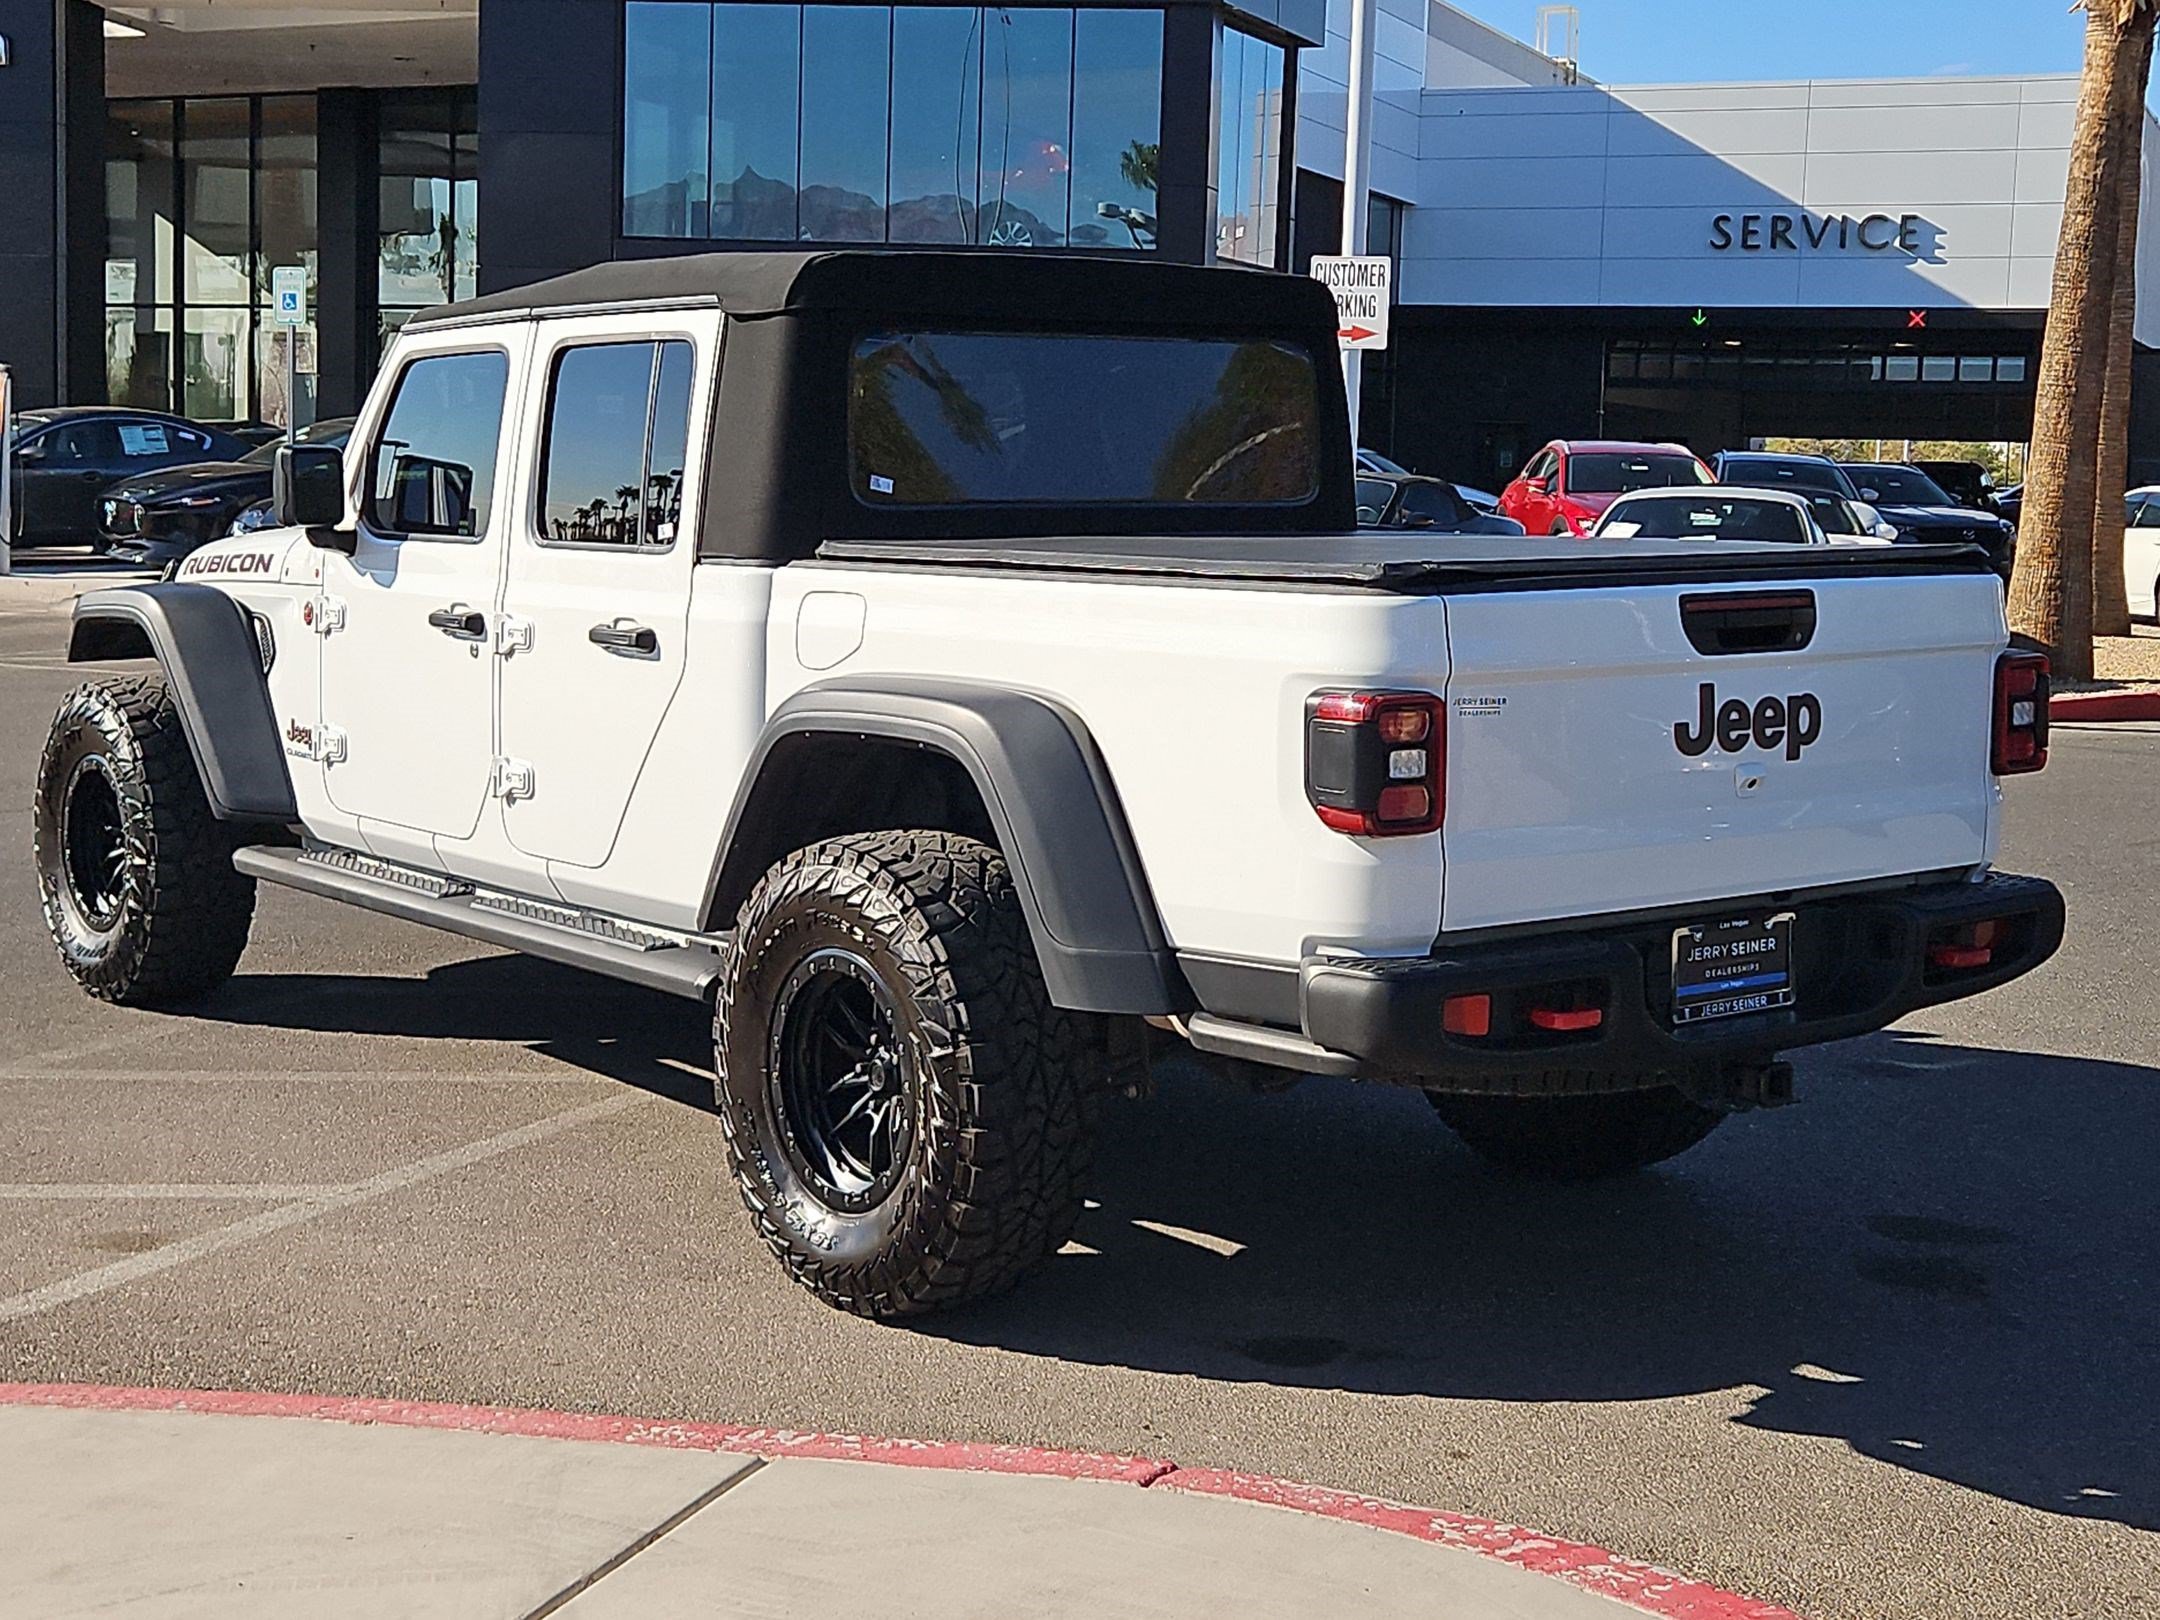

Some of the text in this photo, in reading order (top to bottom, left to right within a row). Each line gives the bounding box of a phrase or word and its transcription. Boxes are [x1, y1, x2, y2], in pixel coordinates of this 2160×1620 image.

[1709, 214, 1920, 250] SERVICE
[1315, 262, 1386, 287] CUSTOMER
[1337, 293, 1377, 318] RKING
[183, 553, 275, 576] RUBICON
[1673, 682, 1822, 762] Jeep
[1687, 937, 1777, 962] JERRY SEINER
[1704, 963, 1760, 978] DEALERSHIPS
[1701, 995, 1768, 1017] JERRY SEINER
